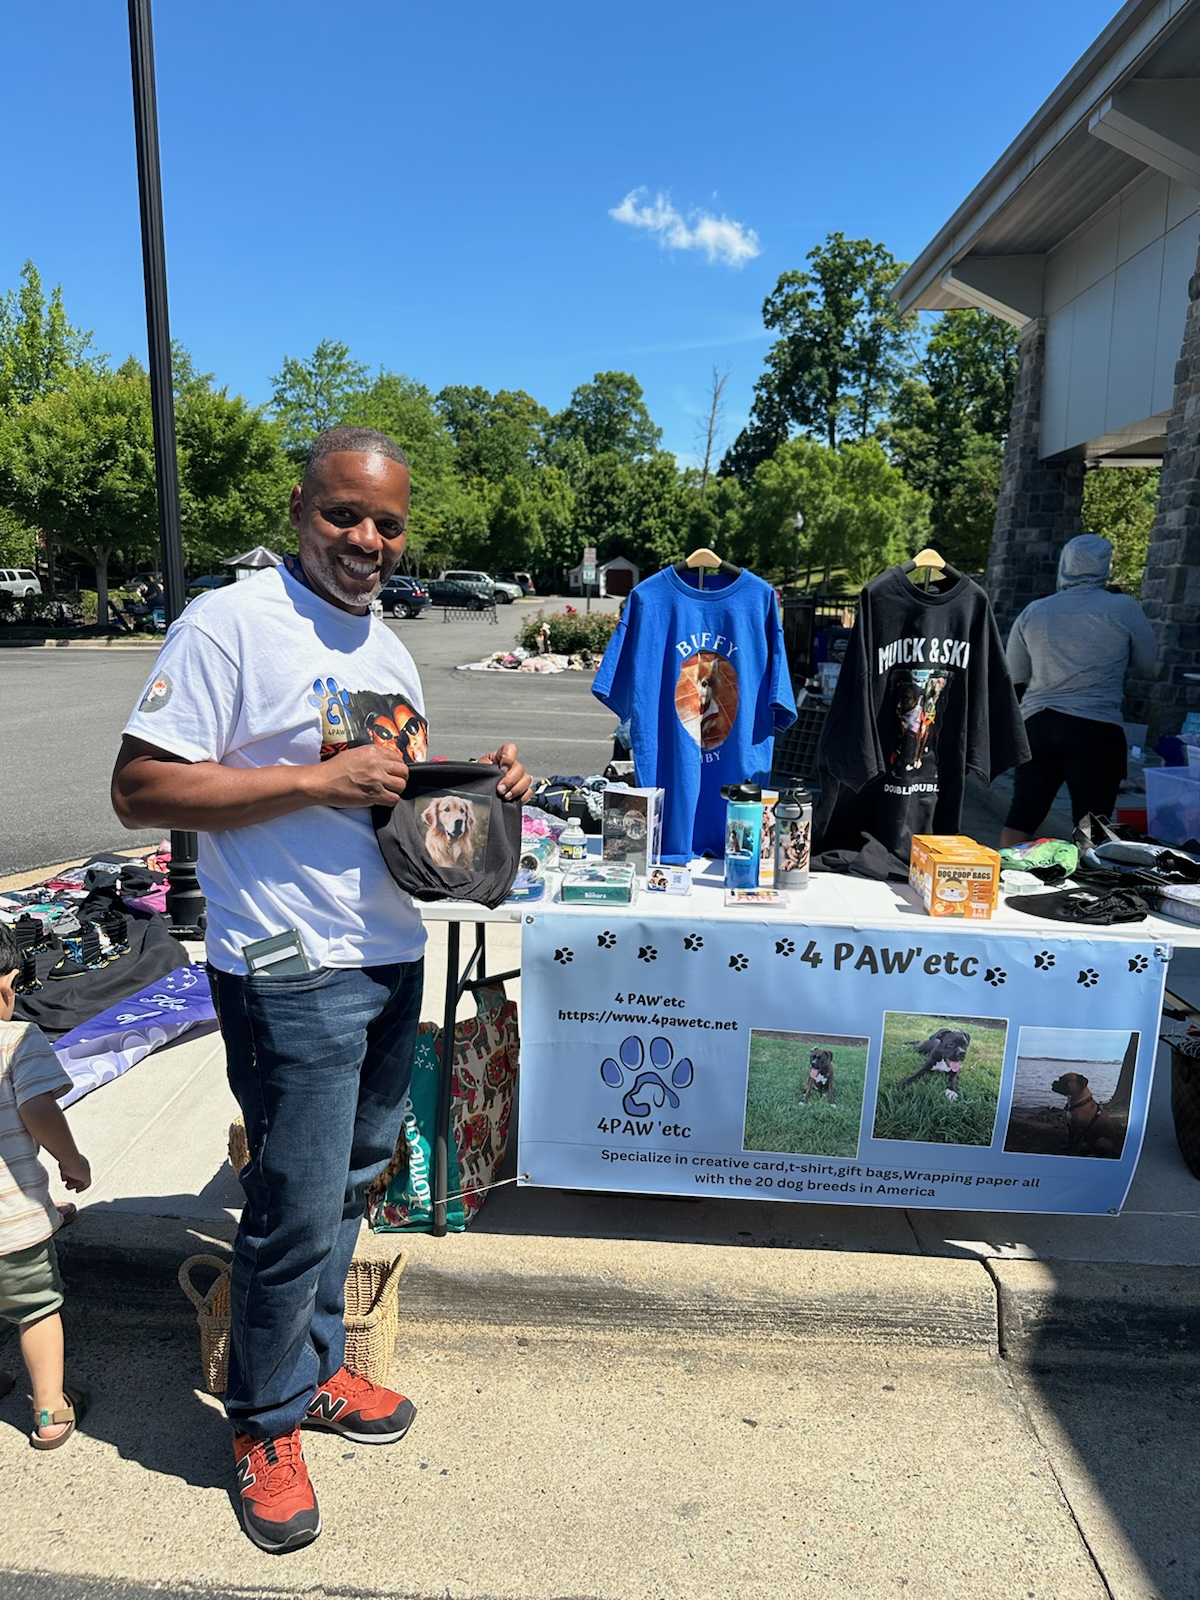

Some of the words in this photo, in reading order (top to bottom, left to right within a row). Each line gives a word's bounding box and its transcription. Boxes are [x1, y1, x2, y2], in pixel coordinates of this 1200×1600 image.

[675, 632, 738, 658] BUFFY
[937, 870, 952, 878] DOG
[953, 871, 972, 879] POOP
[972, 872, 991, 880] BAGS
[800, 940, 823, 969] 4
[834, 942, 979, 977] PAW'etc
[615, 992, 624, 1004] 4
[628, 993, 686, 1008] PAW'etc
[558, 1010, 739, 1031] https://www.4pawetc.net
[601, 1149, 672, 1164] Specialize
[675, 1153, 688, 1165] in
[692, 1156, 749, 1169] creative
[753, 1161, 862, 1179] card,t-shirt,gift
[866, 1167, 973, 1186] bags,Wrapping
[976, 1177, 1019, 1188] paper
[1022, 1177, 1041, 1188] all
[694, 1172, 725, 1185] with
[729, 1174, 752, 1186] the
[755, 1177, 773, 1188] 20
[777, 1177, 804, 1192] dog
[807, 1179, 856, 1193] breeds
[860, 1182, 873, 1194] in
[876, 1184, 936, 1198] America
